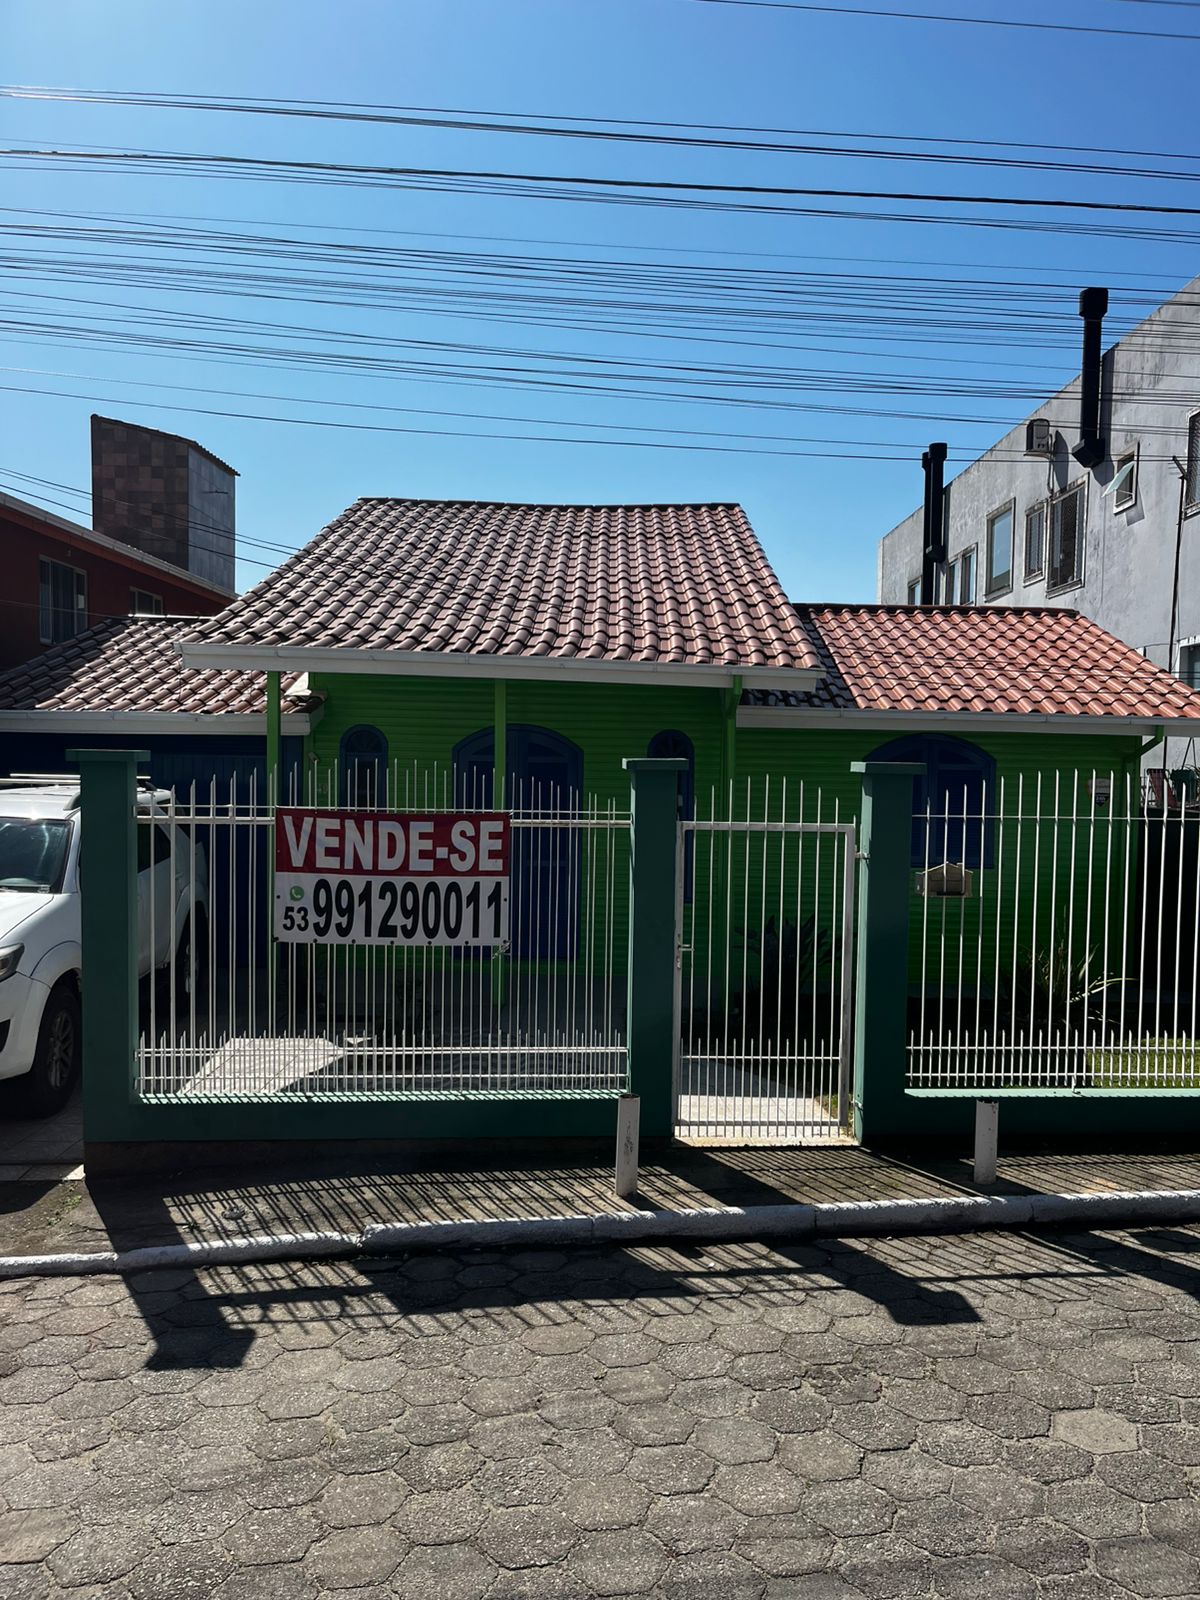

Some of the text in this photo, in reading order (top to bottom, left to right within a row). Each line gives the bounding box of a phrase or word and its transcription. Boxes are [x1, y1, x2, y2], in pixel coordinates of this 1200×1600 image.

[282, 815, 504, 872] VENDE-SE
[282, 878, 502, 939] 53 991290011
